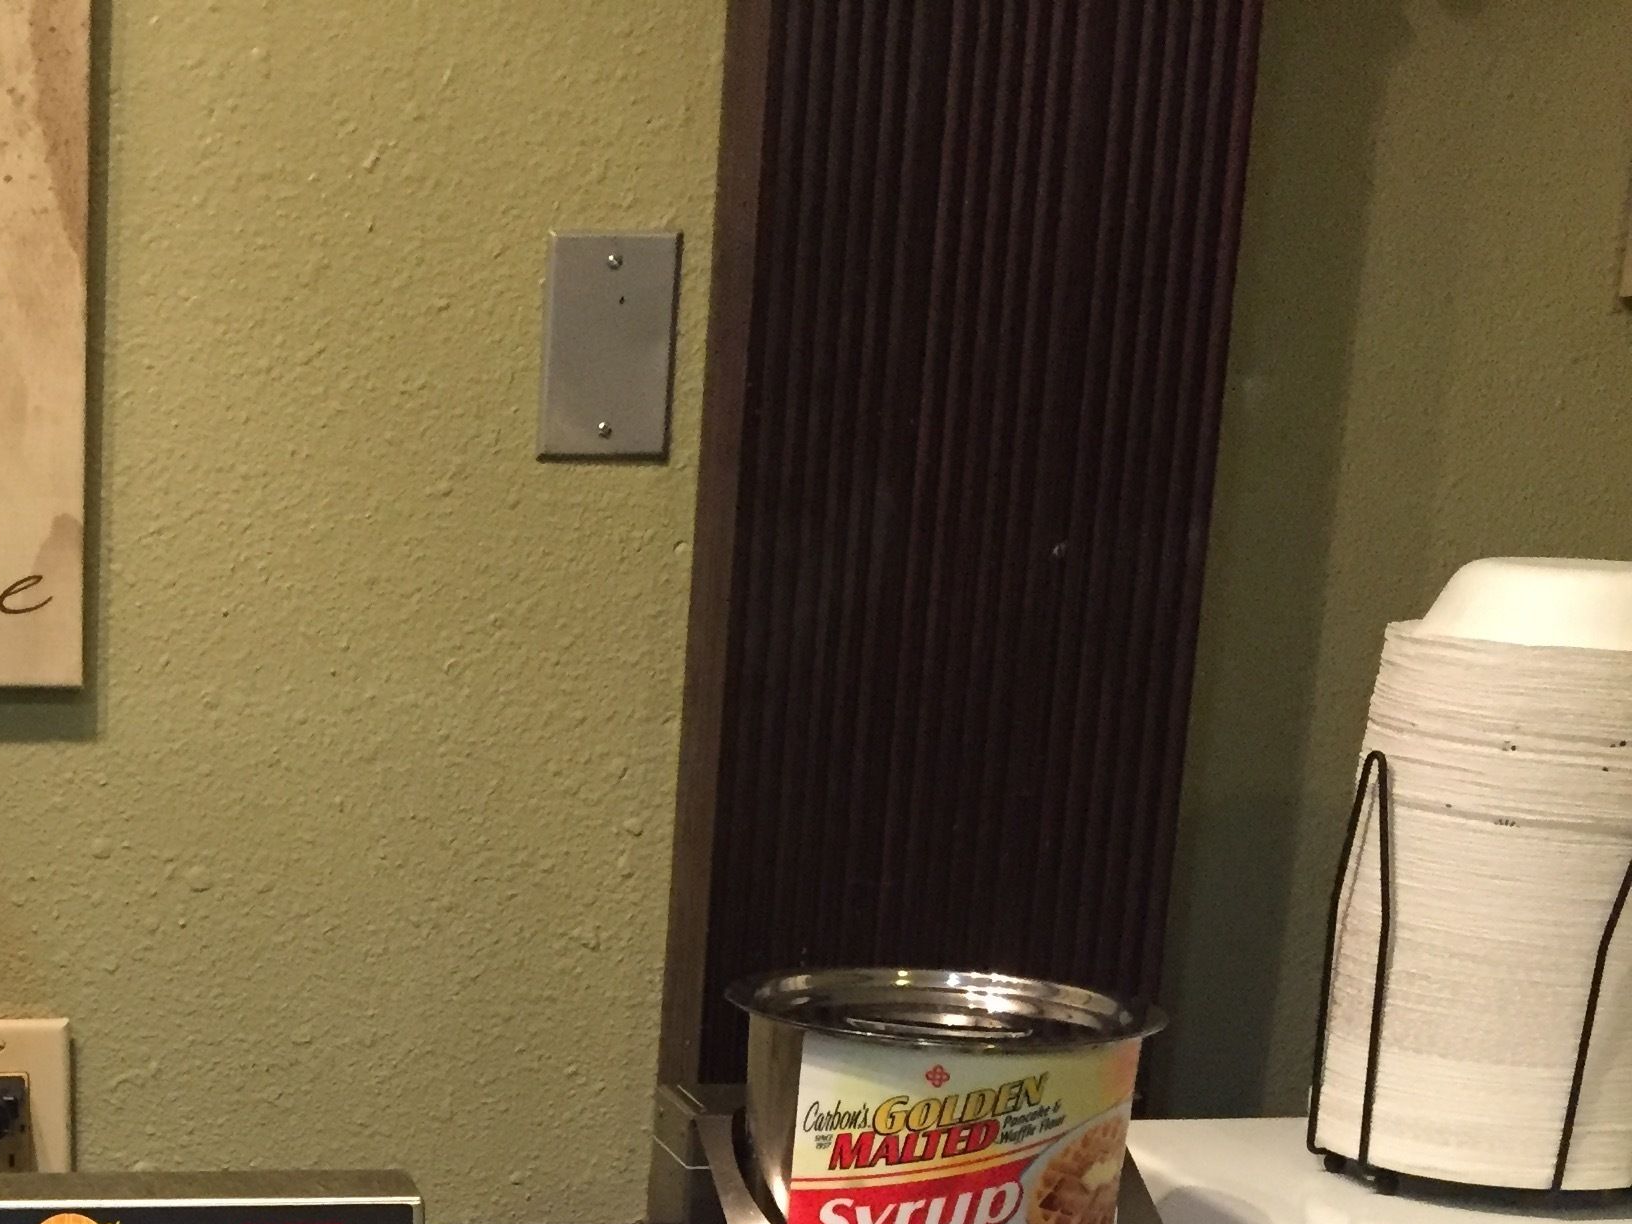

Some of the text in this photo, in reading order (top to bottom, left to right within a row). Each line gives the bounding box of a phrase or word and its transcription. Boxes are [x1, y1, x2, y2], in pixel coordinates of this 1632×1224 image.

[802, 1071, 1050, 1136] Carbon's GOLDEN
[1003, 1105, 1051, 1129] Pancake
[828, 1119, 1000, 1171] MALTED
